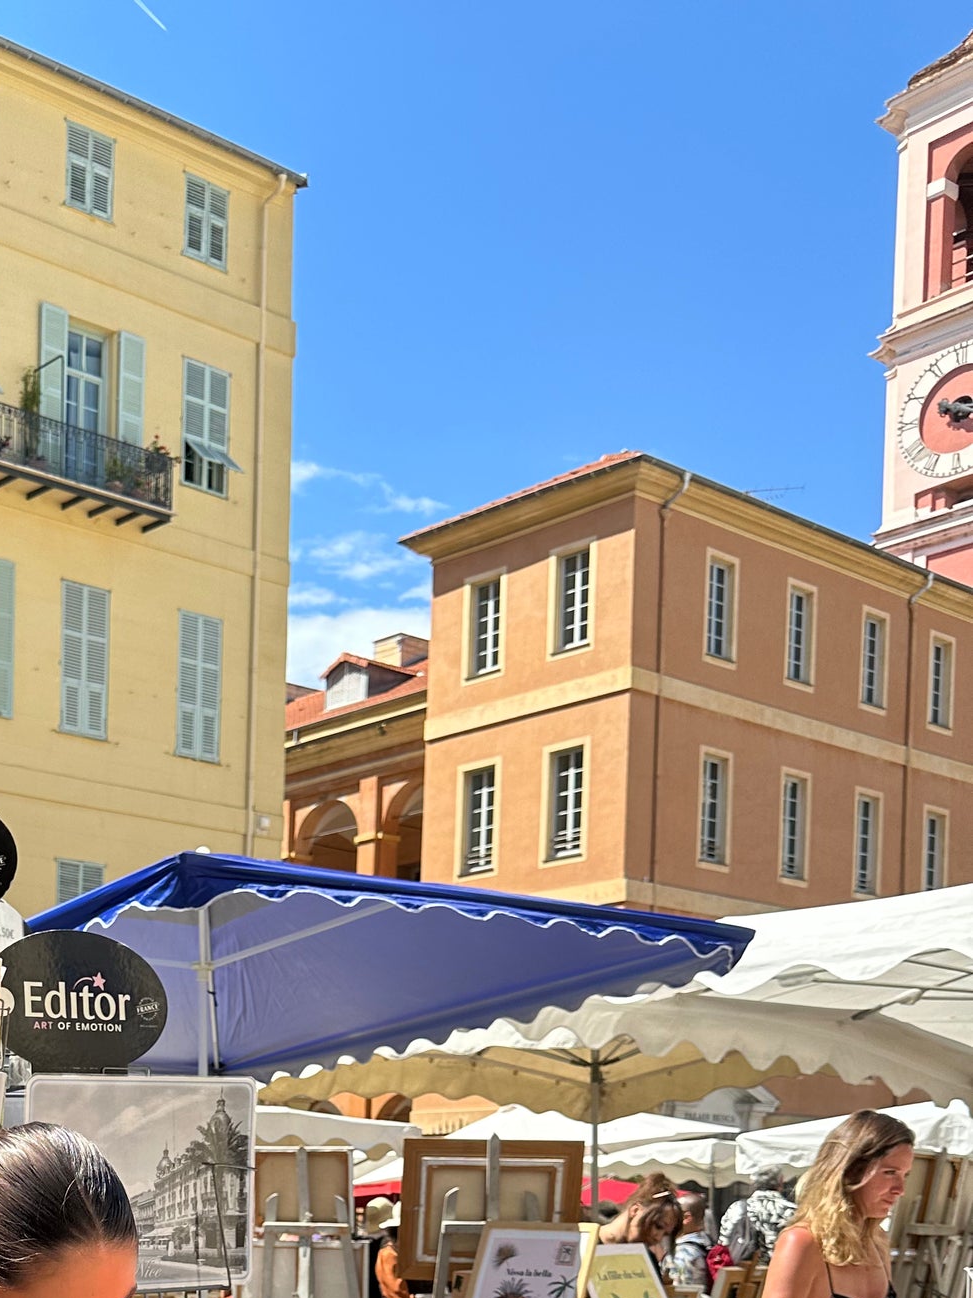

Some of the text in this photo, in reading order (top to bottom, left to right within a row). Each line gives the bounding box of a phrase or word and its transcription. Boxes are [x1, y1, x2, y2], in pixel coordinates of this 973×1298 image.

[23, 981, 130, 1021] Editor
[136, 1004, 160, 1014] FRANCE
[34, 1021, 122, 1032] ART OF EMOTION
